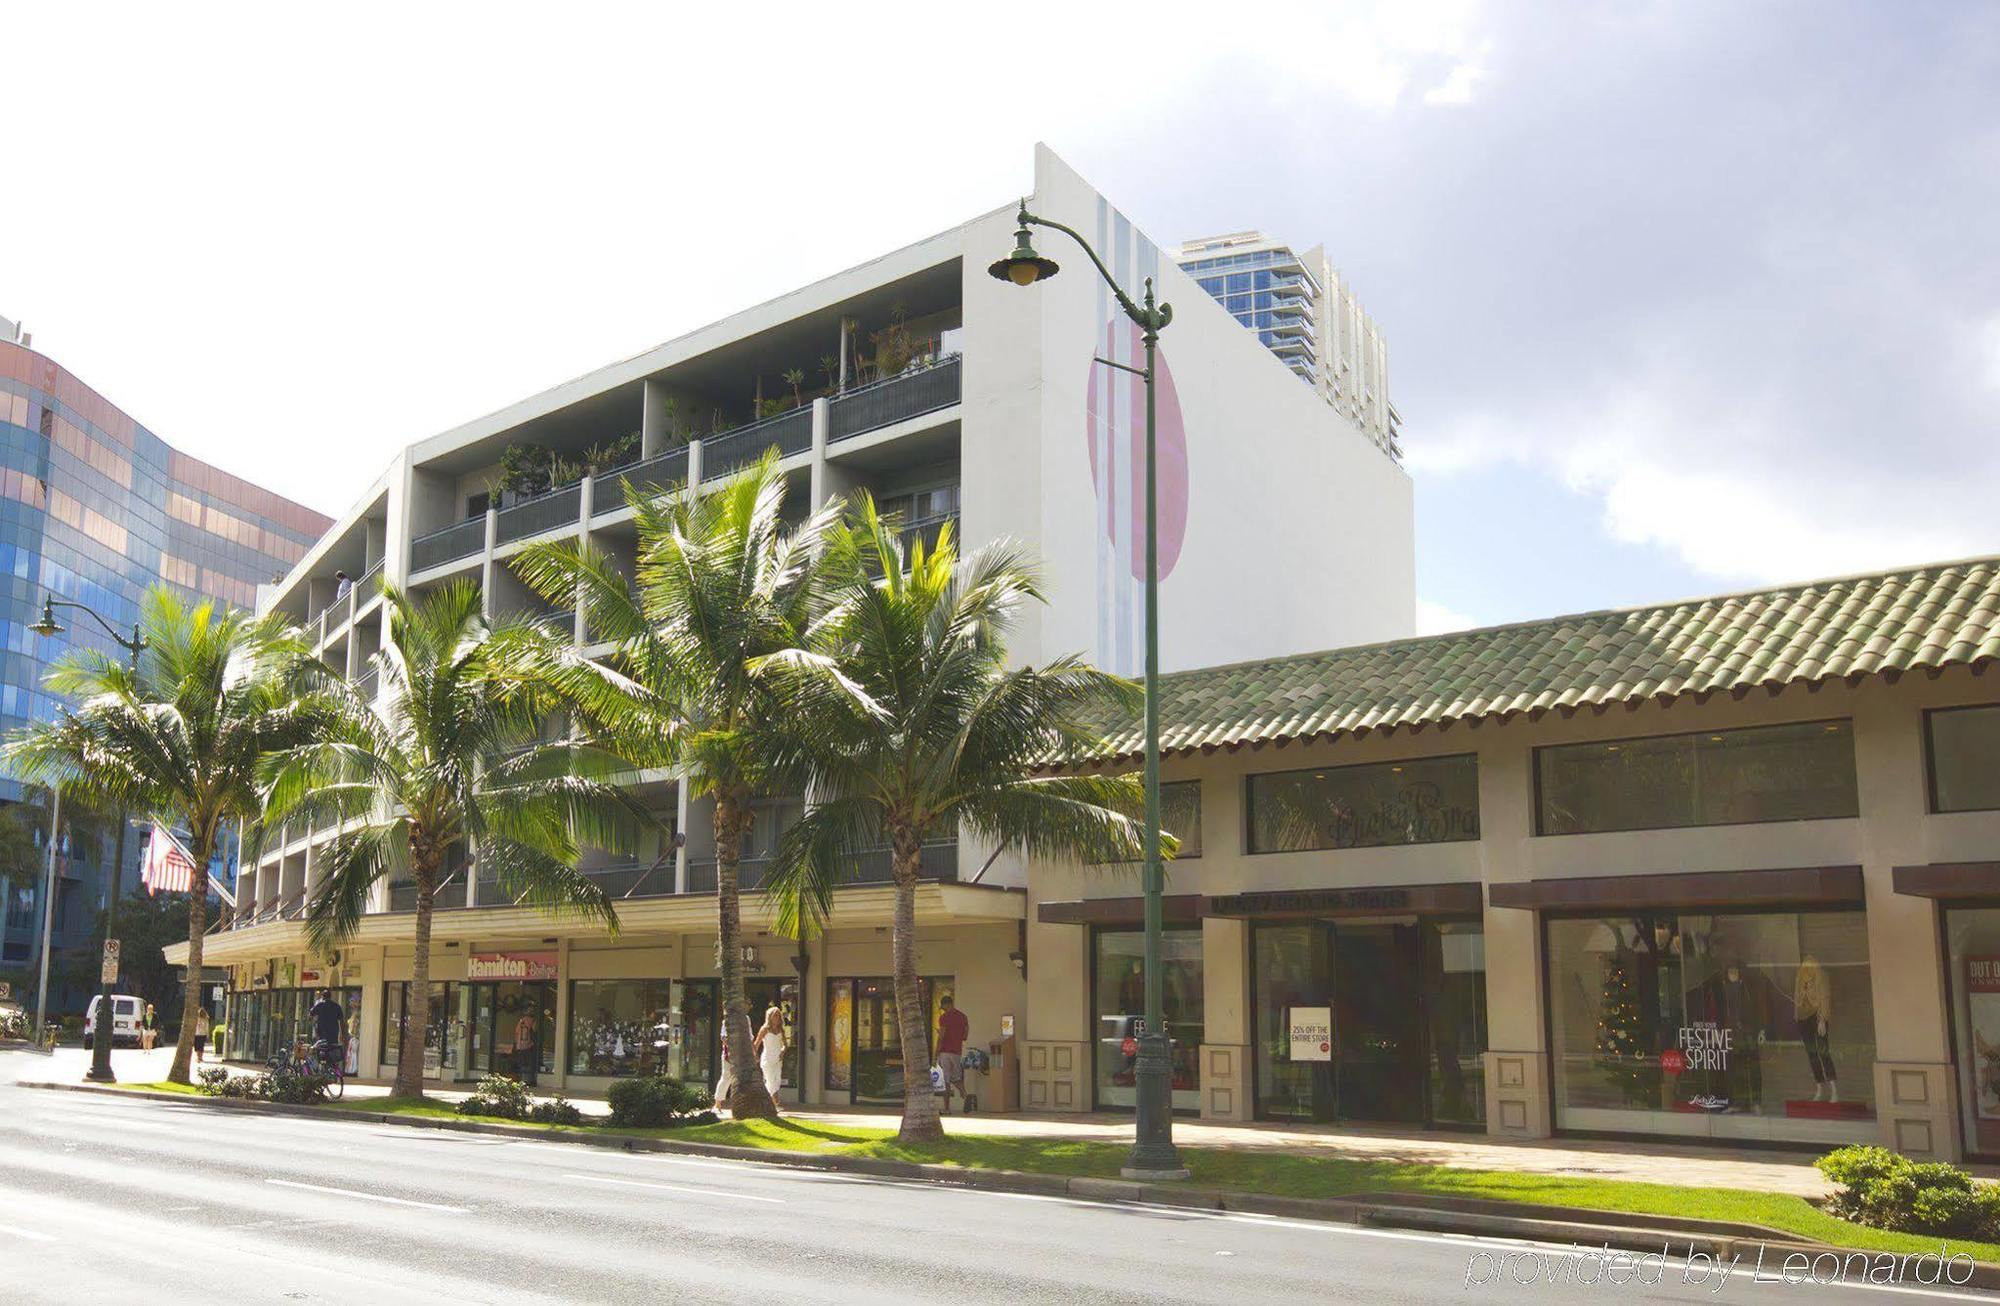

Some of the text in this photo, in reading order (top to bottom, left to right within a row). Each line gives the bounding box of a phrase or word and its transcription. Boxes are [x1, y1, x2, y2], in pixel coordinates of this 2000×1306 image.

[467, 953, 527, 977] Hamilton
[1970, 960, 1991, 978] OUT
[1292, 1034, 1311, 1042] ENTIRE
[1305, 1025, 1316, 1034] OFF
[1317, 1025, 1328, 1034] THE
[1679, 1027, 1733, 1050] FESTIVE
[1685, 1048, 1728, 1071] SPIRIT
